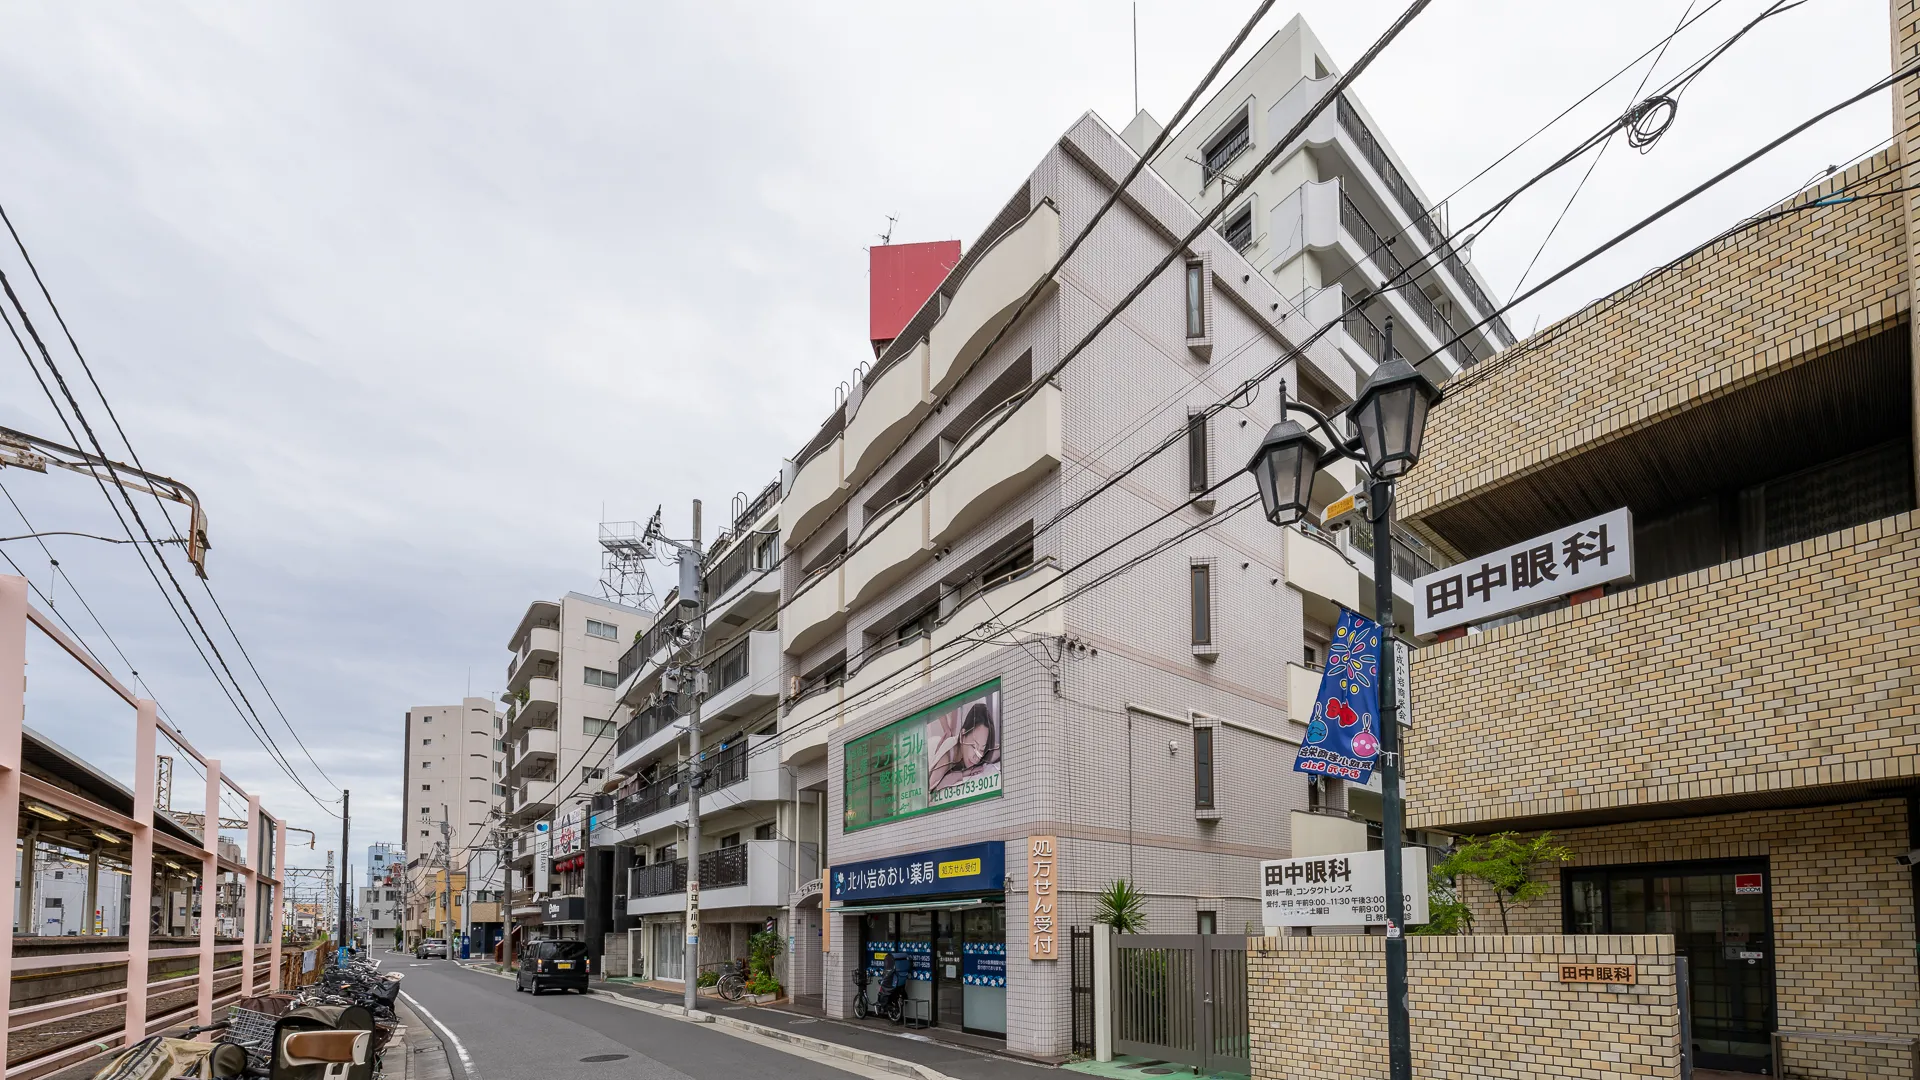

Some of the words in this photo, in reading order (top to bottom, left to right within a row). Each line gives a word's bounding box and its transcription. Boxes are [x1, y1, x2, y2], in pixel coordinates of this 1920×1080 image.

[1426, 524, 1615, 619] 田中眼科
[1396, 643, 1406, 721] 京成小岩商栄会
[871, 733, 923, 769] ナチュラル
[880, 762, 916, 793] 整体院
[944, 774, 999, 799] 03-6753-9017
[901, 788, 922, 800] SEITAI
[848, 861, 934, 891] 北小岩あおい薬局
[942, 862, 977, 875] 処方せん受付
[1265, 858, 1351, 886] 田中眼科
[1033, 840, 1053, 954] 処方せん受付
[1562, 966, 1632, 982] 田中眼科
